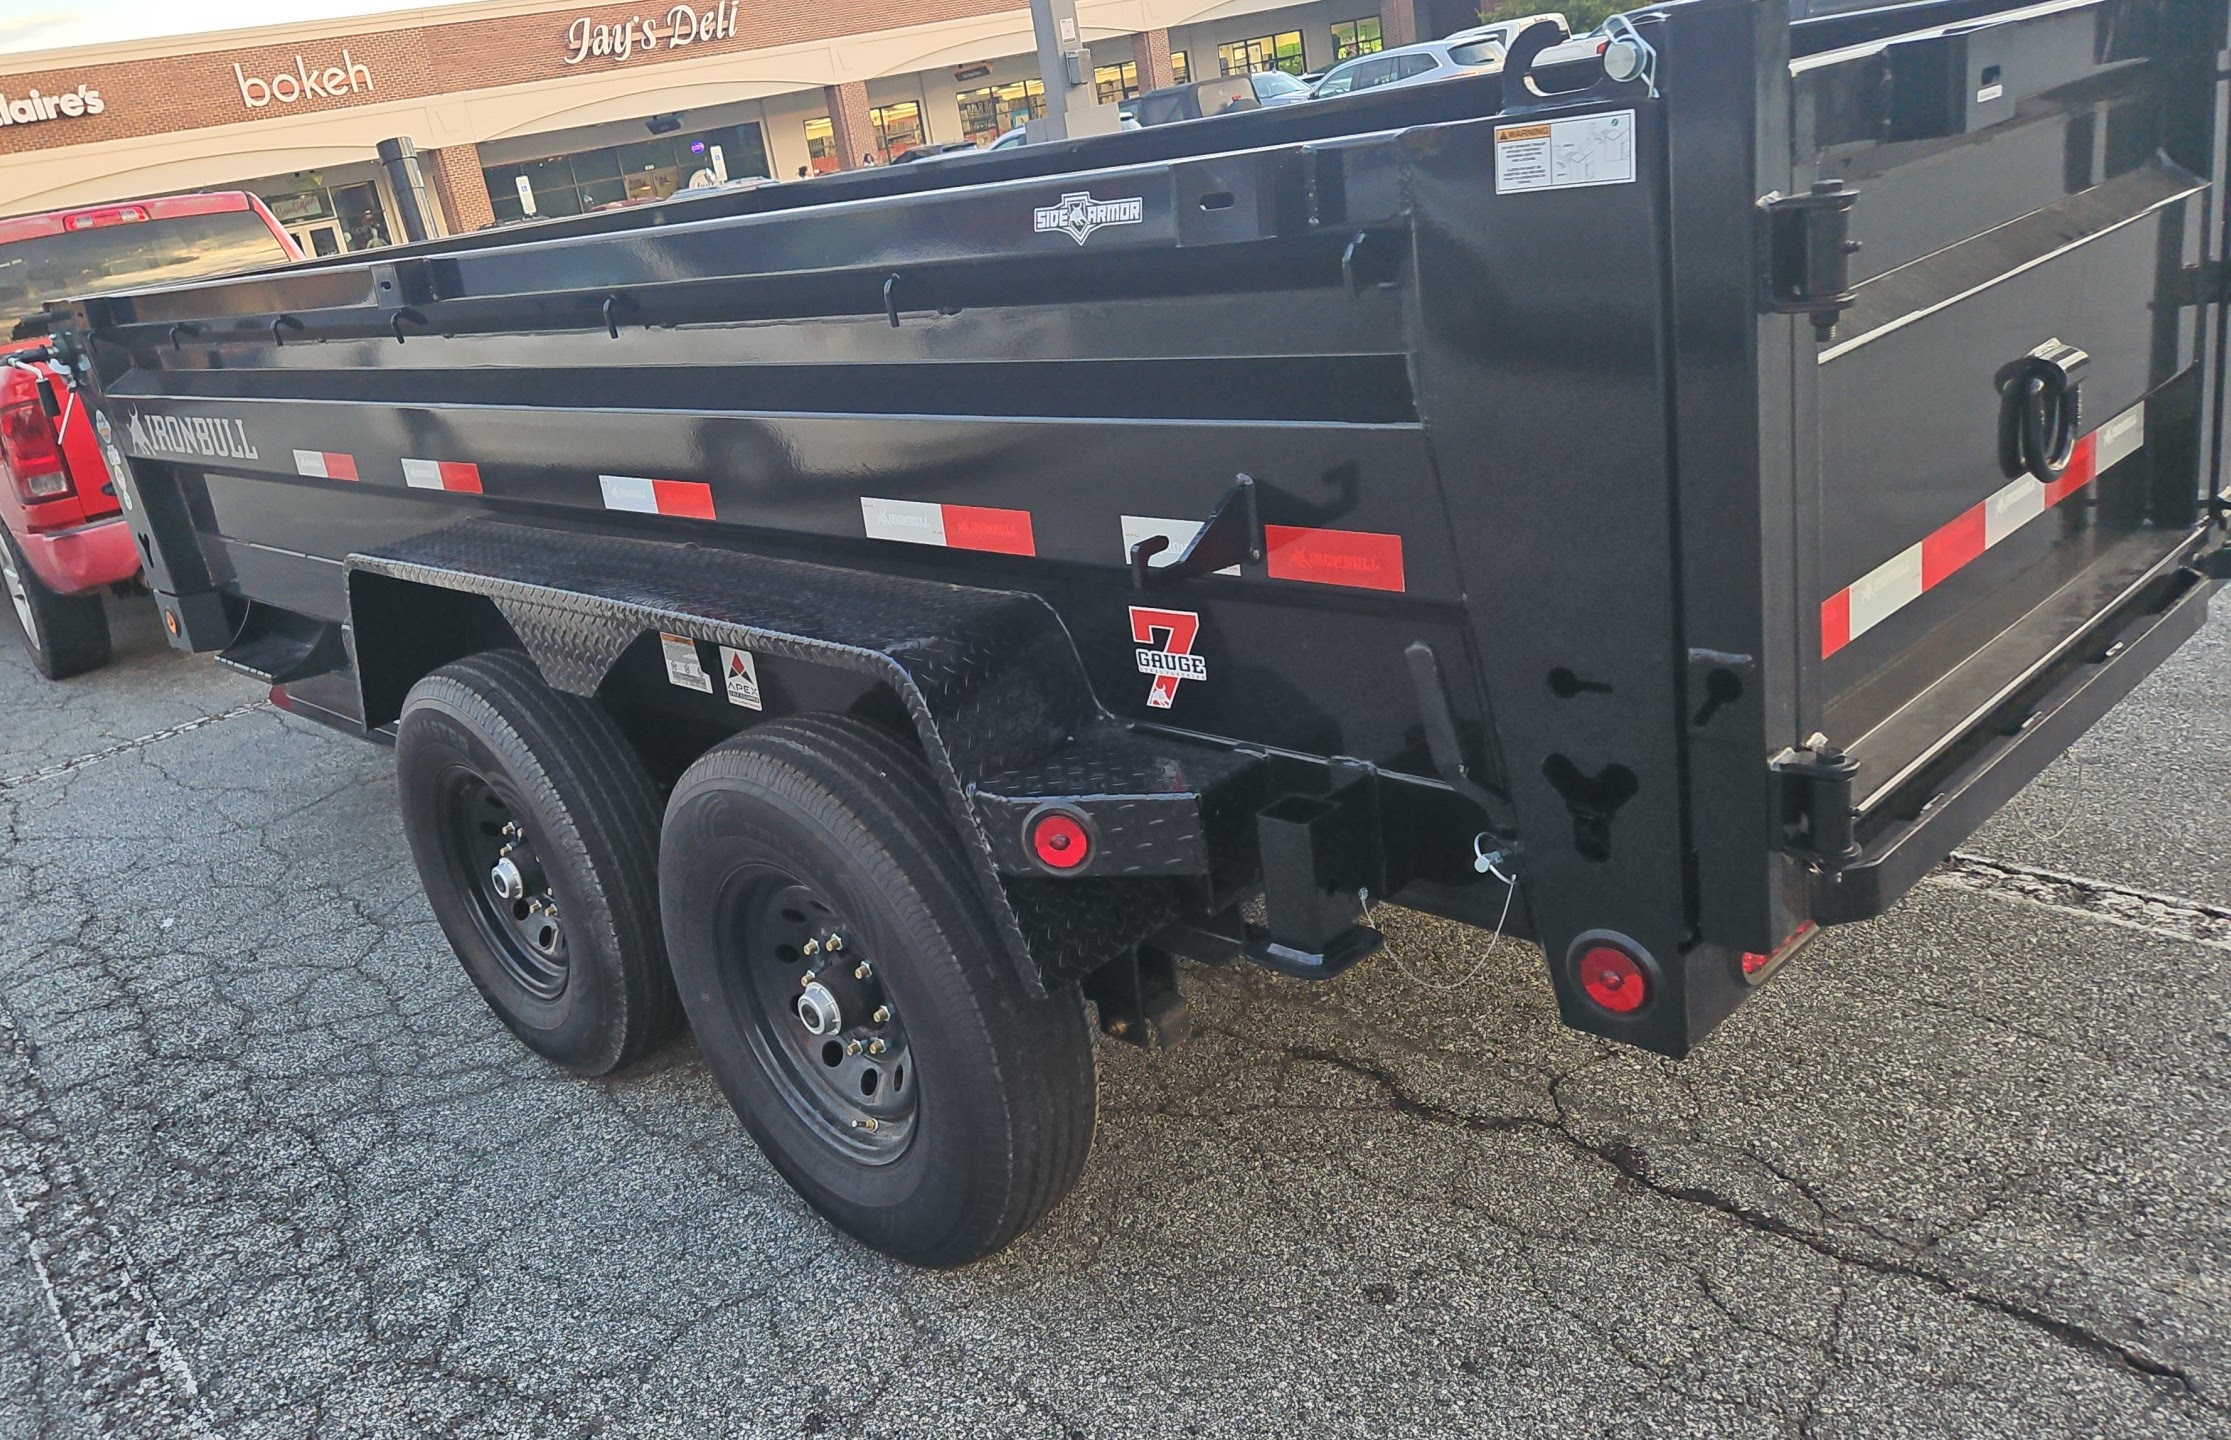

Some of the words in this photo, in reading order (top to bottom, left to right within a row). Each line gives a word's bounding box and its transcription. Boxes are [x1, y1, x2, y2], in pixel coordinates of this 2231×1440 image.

[563, 15, 657, 65] Jay's
[667, 0, 740, 49] Deli
[233, 48, 374, 108] bokeh
[0, 84, 105, 126] laire's
[1508, 126, 1549, 138] WARNING
[1037, 209, 1069, 229] SIDE
[1087, 201, 1140, 223] ARMOR
[144, 414, 259, 460] IRONBULL
[1128, 605, 1200, 709] 7
[1138, 651, 1205, 675] GAUGE
[728, 681, 759, 696] APEX
